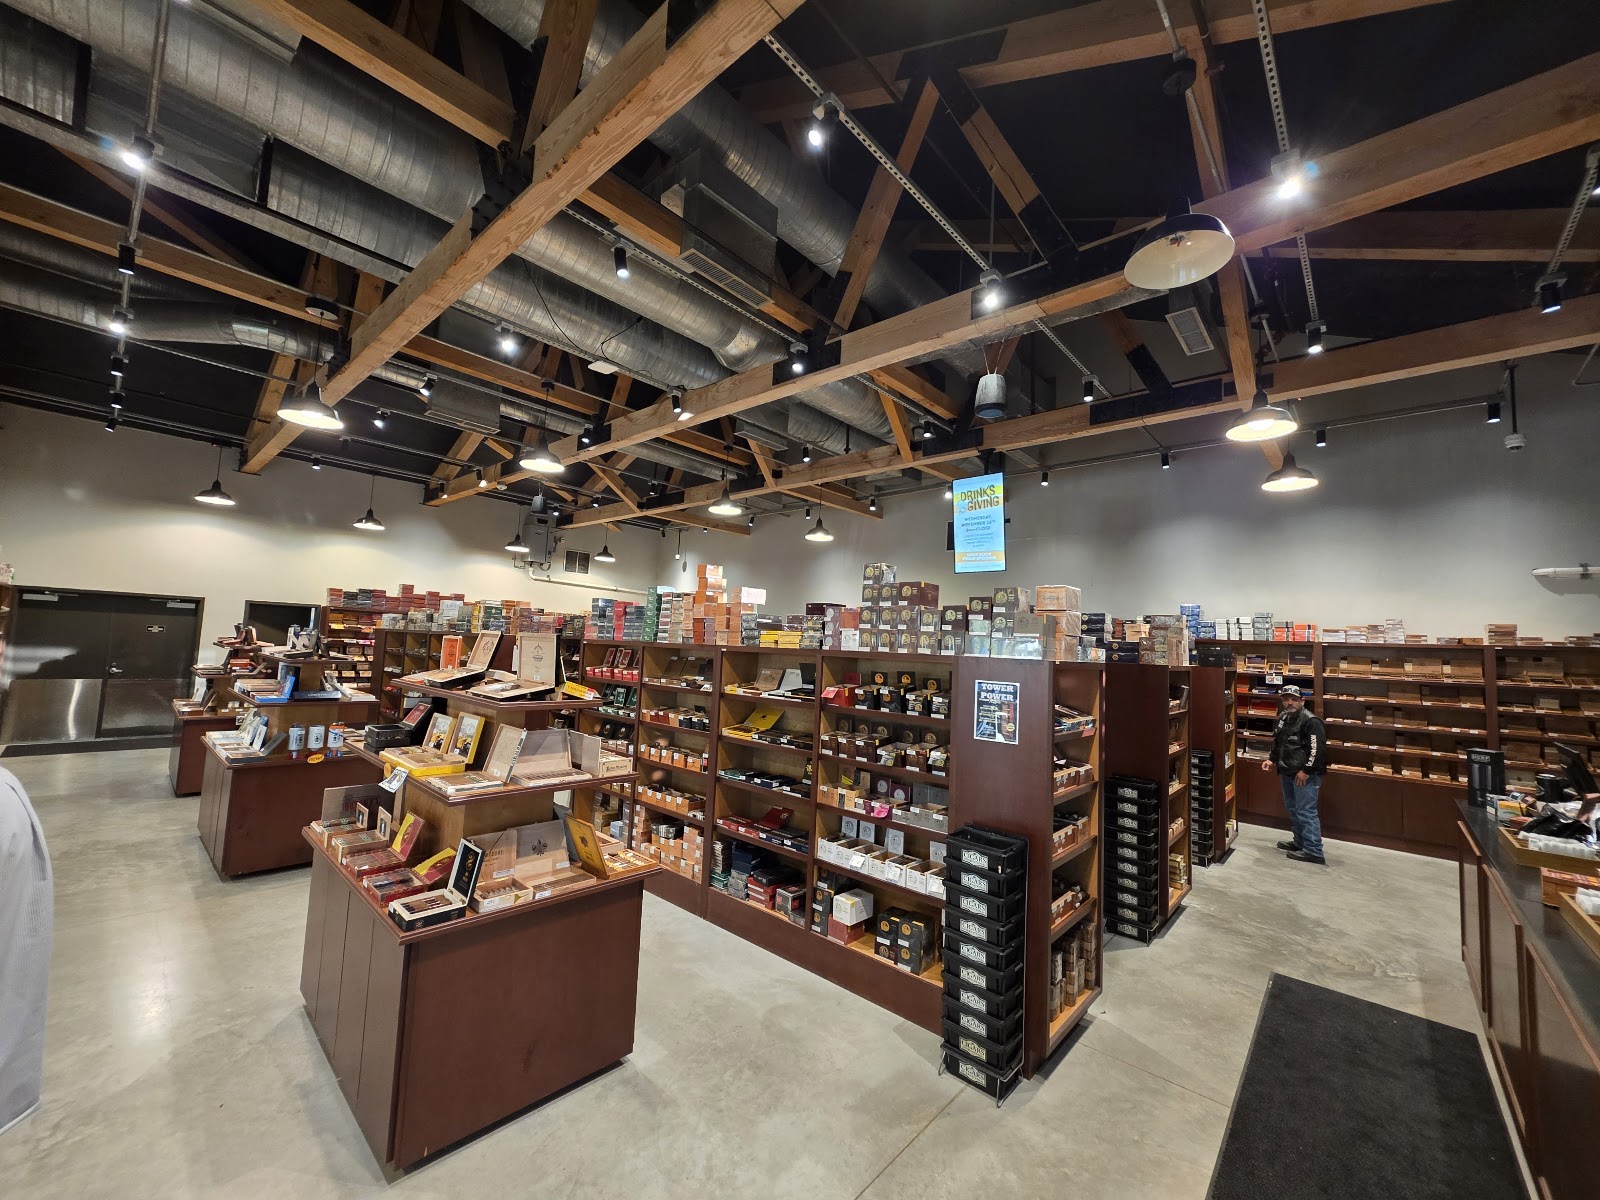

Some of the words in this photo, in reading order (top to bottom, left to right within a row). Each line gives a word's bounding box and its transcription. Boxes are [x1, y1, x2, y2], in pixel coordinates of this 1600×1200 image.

[968, 496, 999, 511] GIVING
[982, 684, 1014, 692] TOWER
[981, 692, 1014, 701] POWER
